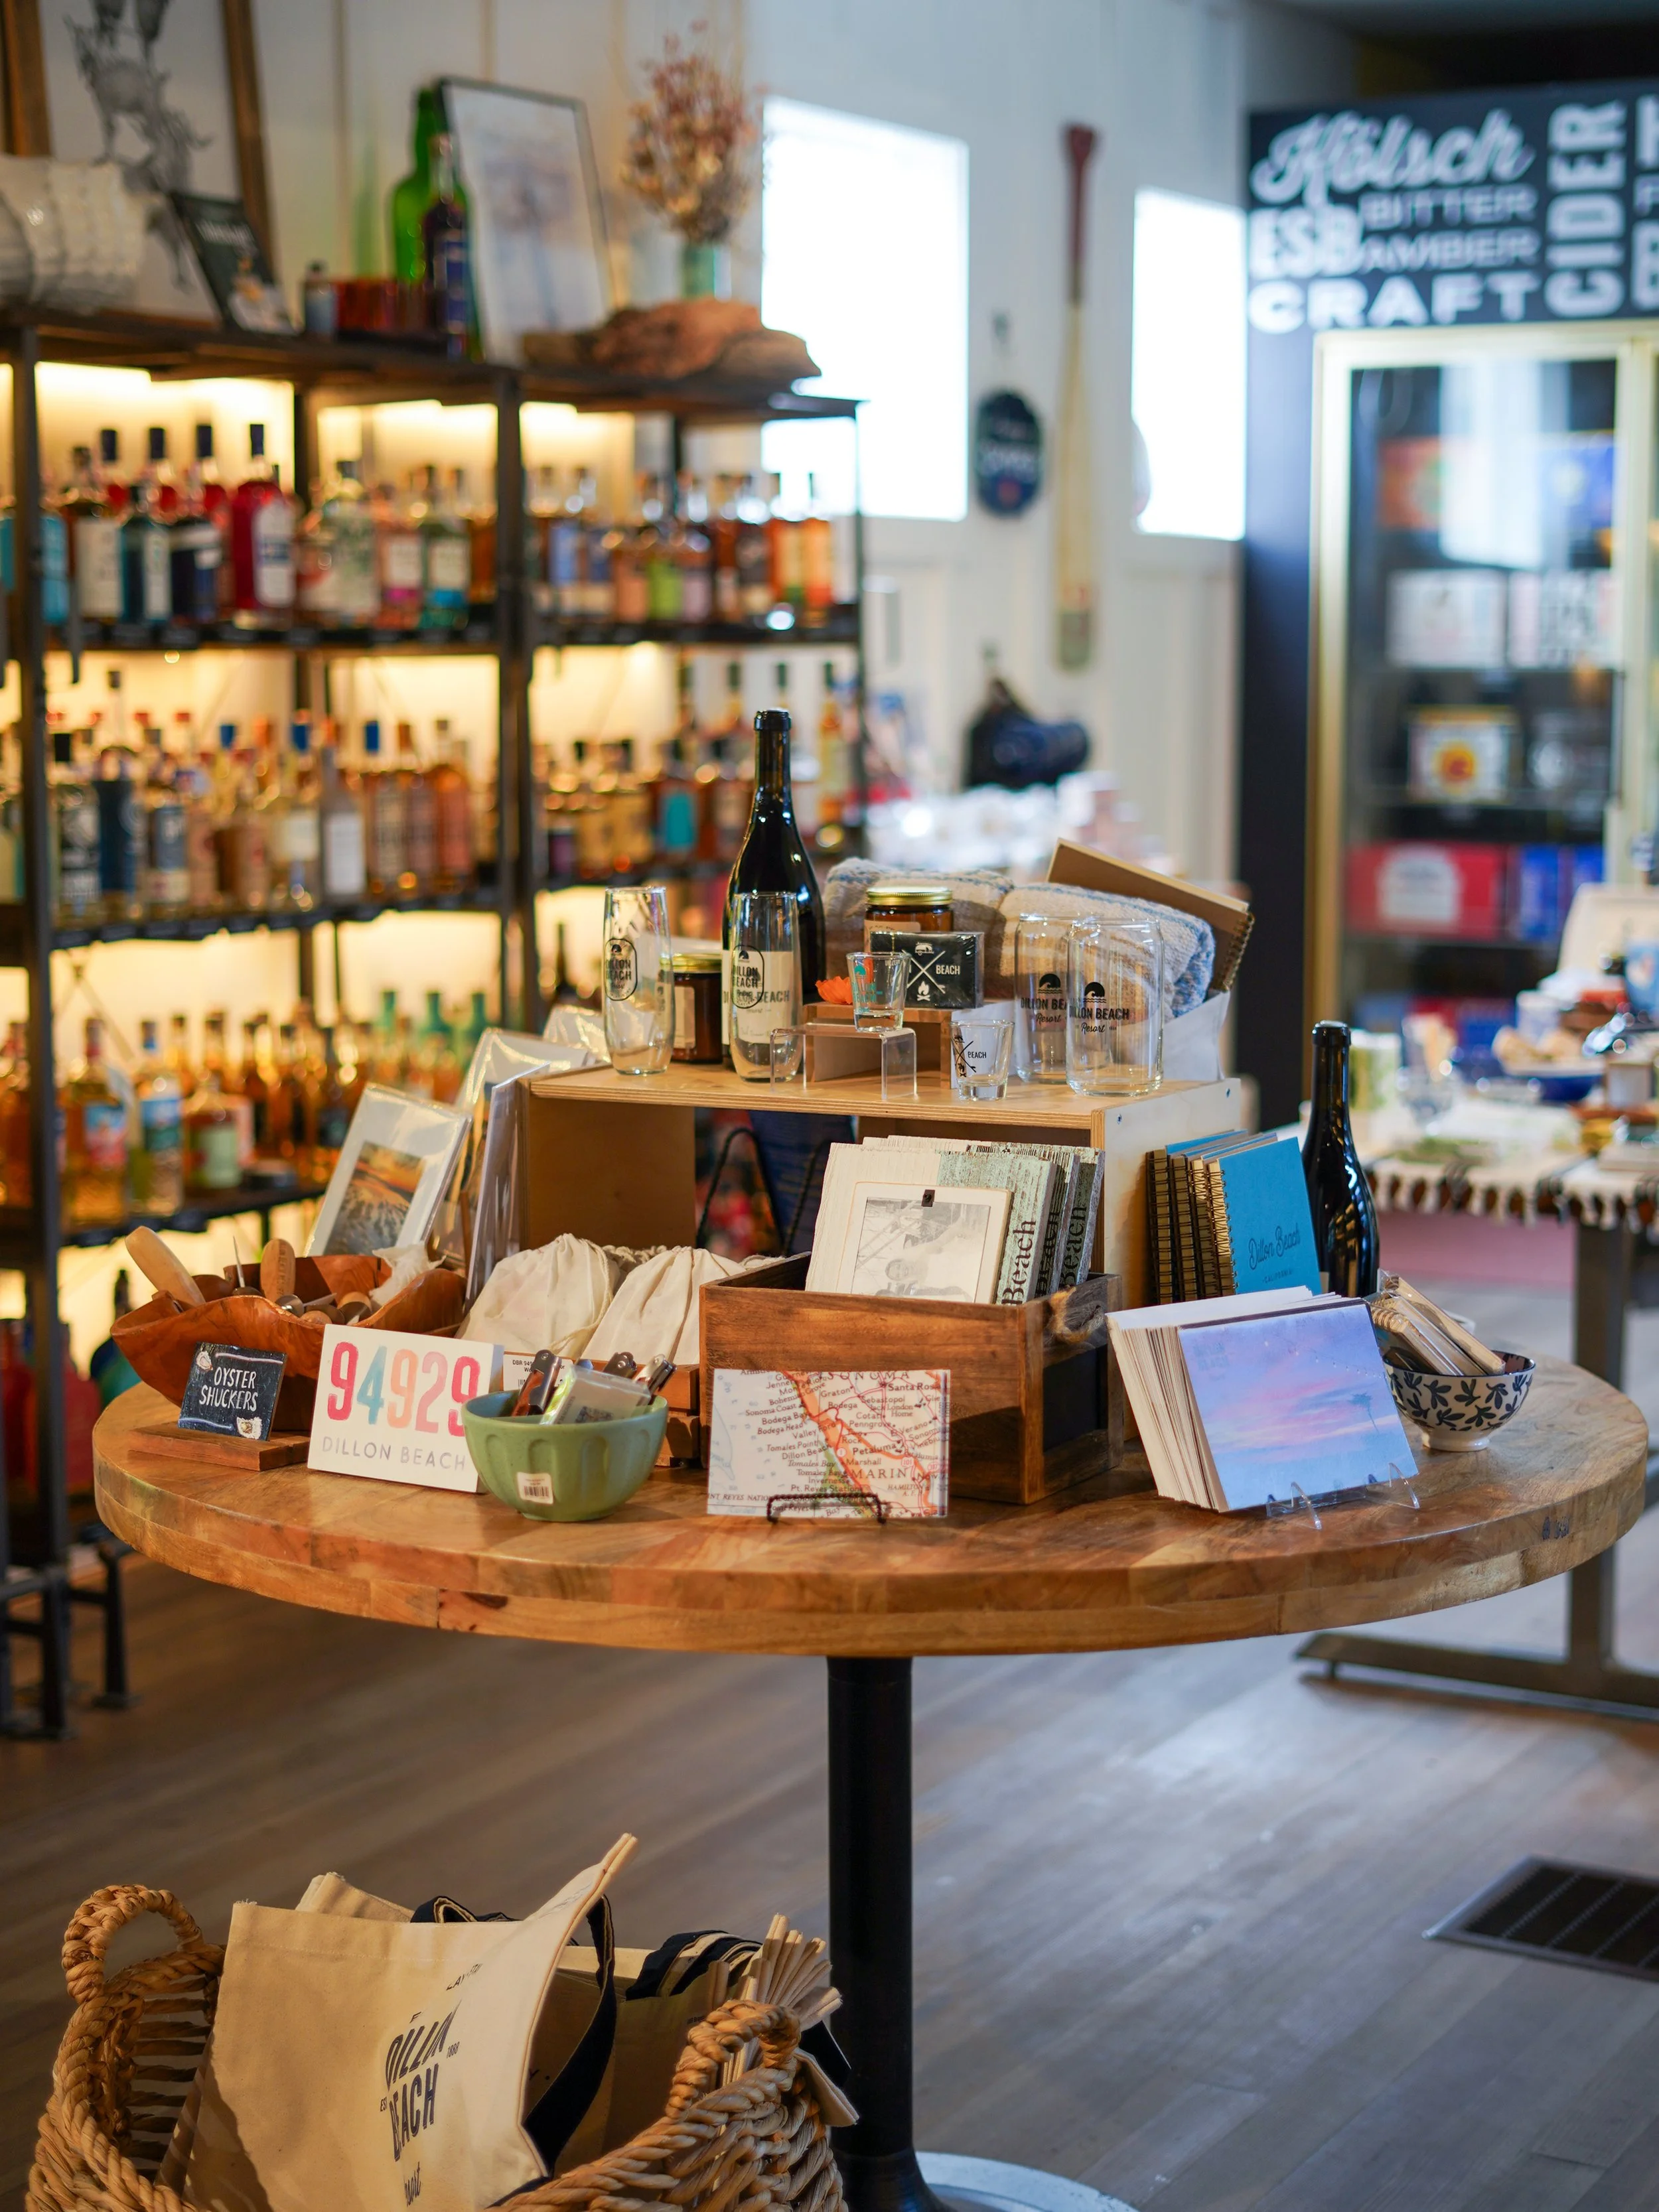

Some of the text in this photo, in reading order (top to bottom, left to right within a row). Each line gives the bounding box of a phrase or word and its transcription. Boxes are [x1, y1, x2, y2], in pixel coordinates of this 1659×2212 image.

[1361, 186, 1537, 227] BITTER
[1548, 102, 1625, 316] CIDER
[1359, 230, 1538, 272] AMBER
[1248, 273, 1539, 332] CRAFT
[936, 965, 960, 975] BEACH
[1021, 998, 1048, 1010] DILLON
[1036, 1012, 1062, 1026] Resort
[1069, 1004, 1130, 1020] DILLON BEACH
[1080, 1022, 1106, 1035] Resort
[1248, 1222, 1301, 1270] Dillon Beach
[1001, 1219, 1036, 1305] Beach
[214, 1366, 257, 1389] OYSTER
[327, 1342, 480, 1437] 94929
[820, 1387, 850, 1397] Graton
[199, 1384, 258, 1412] SHUCKERS
[776, 1403, 796, 1413] Coast
[828, 1401, 857, 1411] Bodega
[762, 1415, 792, 1426] Bodega
[757, 1422, 804, 1436] Bodega Head
[792, 1428, 817, 1439] Valley
[782, 1443, 831, 1460] Dillon Beach
[797, 1440, 818, 1449] Point
[853, 1443, 897, 1455] Petaluma
[323, 1436, 466, 1471] DILLON BEACH
[821, 1460, 836, 1469] Bay
[852, 1468, 907, 1480] MARIN
